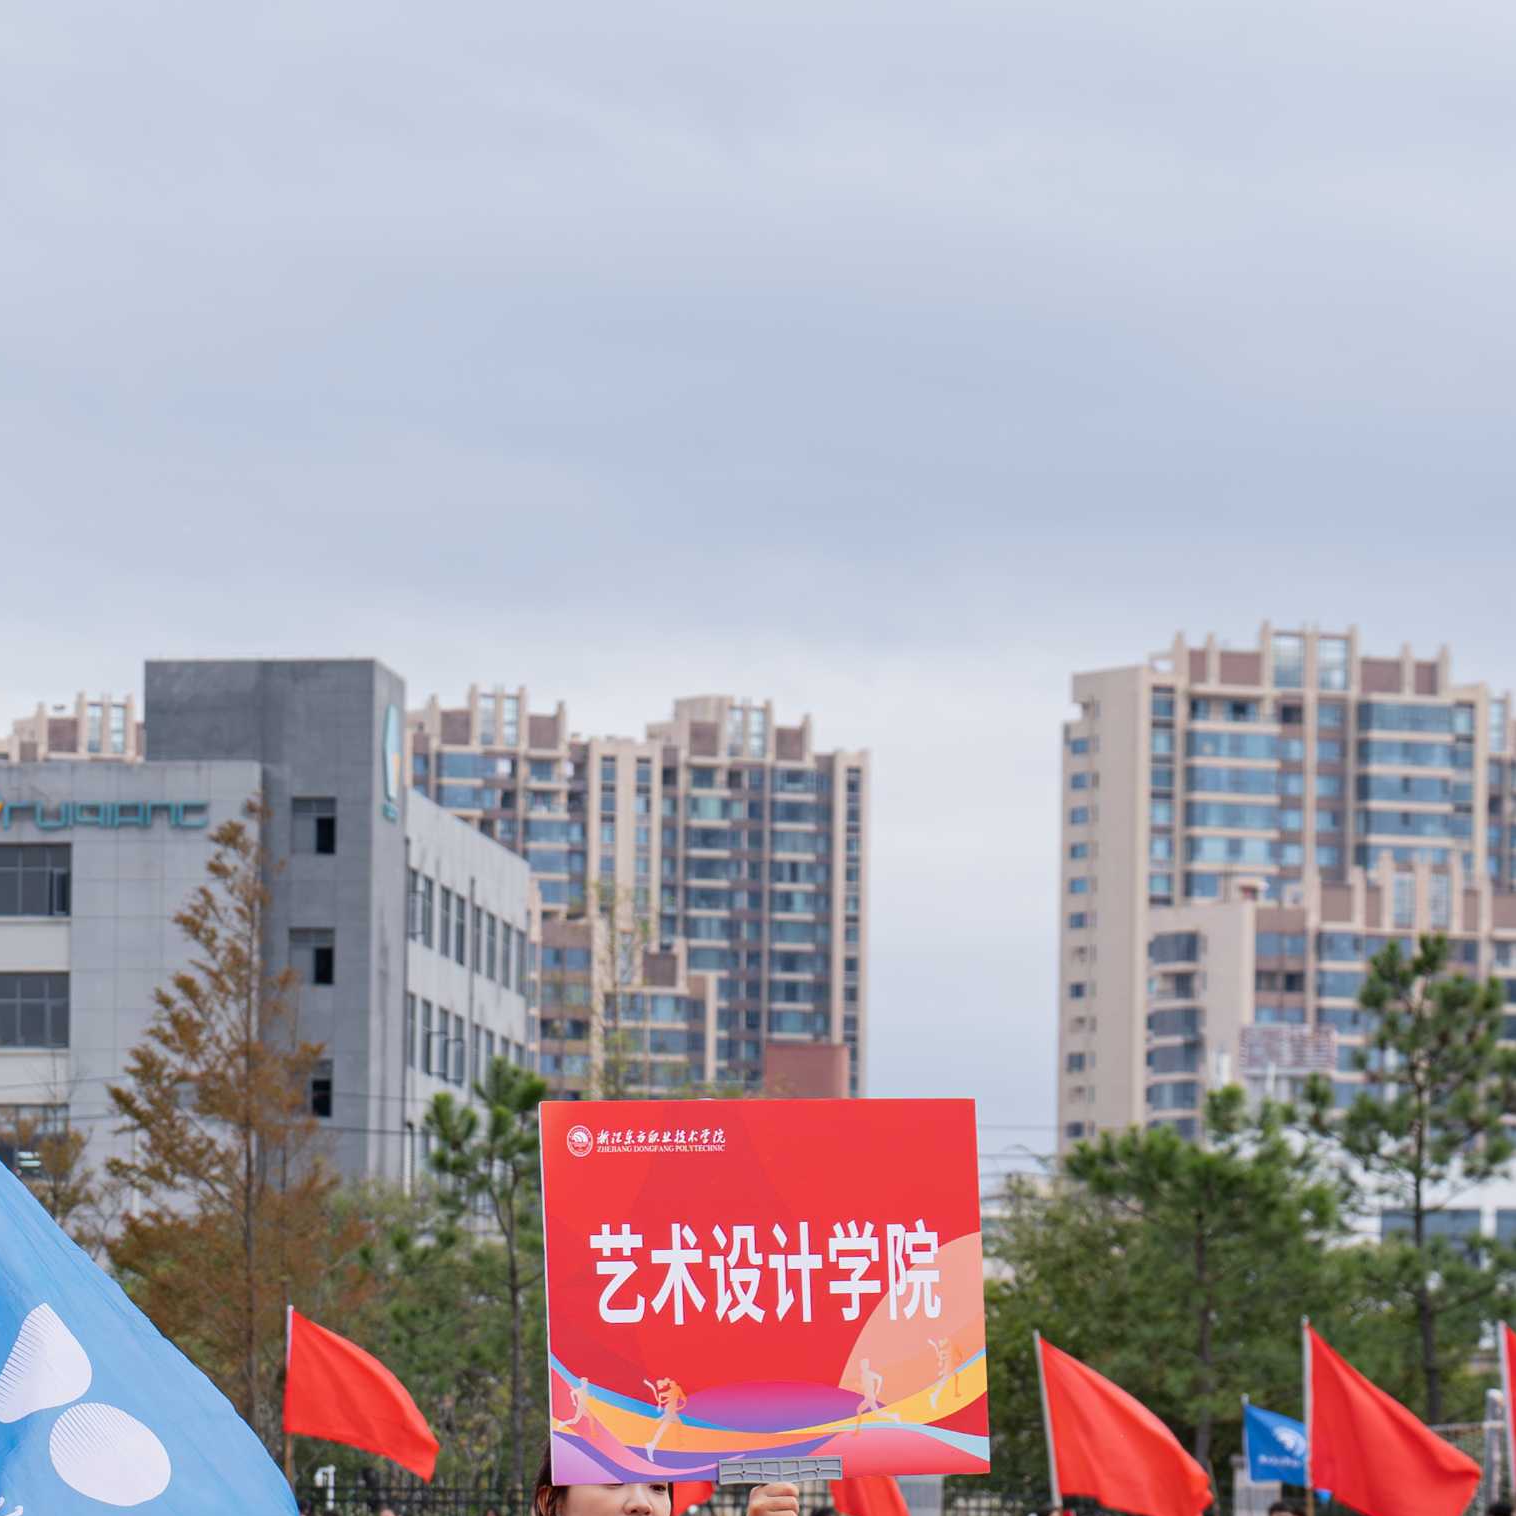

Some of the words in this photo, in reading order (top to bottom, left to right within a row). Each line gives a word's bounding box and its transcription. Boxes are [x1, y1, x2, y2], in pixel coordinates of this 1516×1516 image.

[596, 1128, 726, 1144] 浙江东方职业技术学院
[589, 1218, 943, 1326] 艺术设计学院
